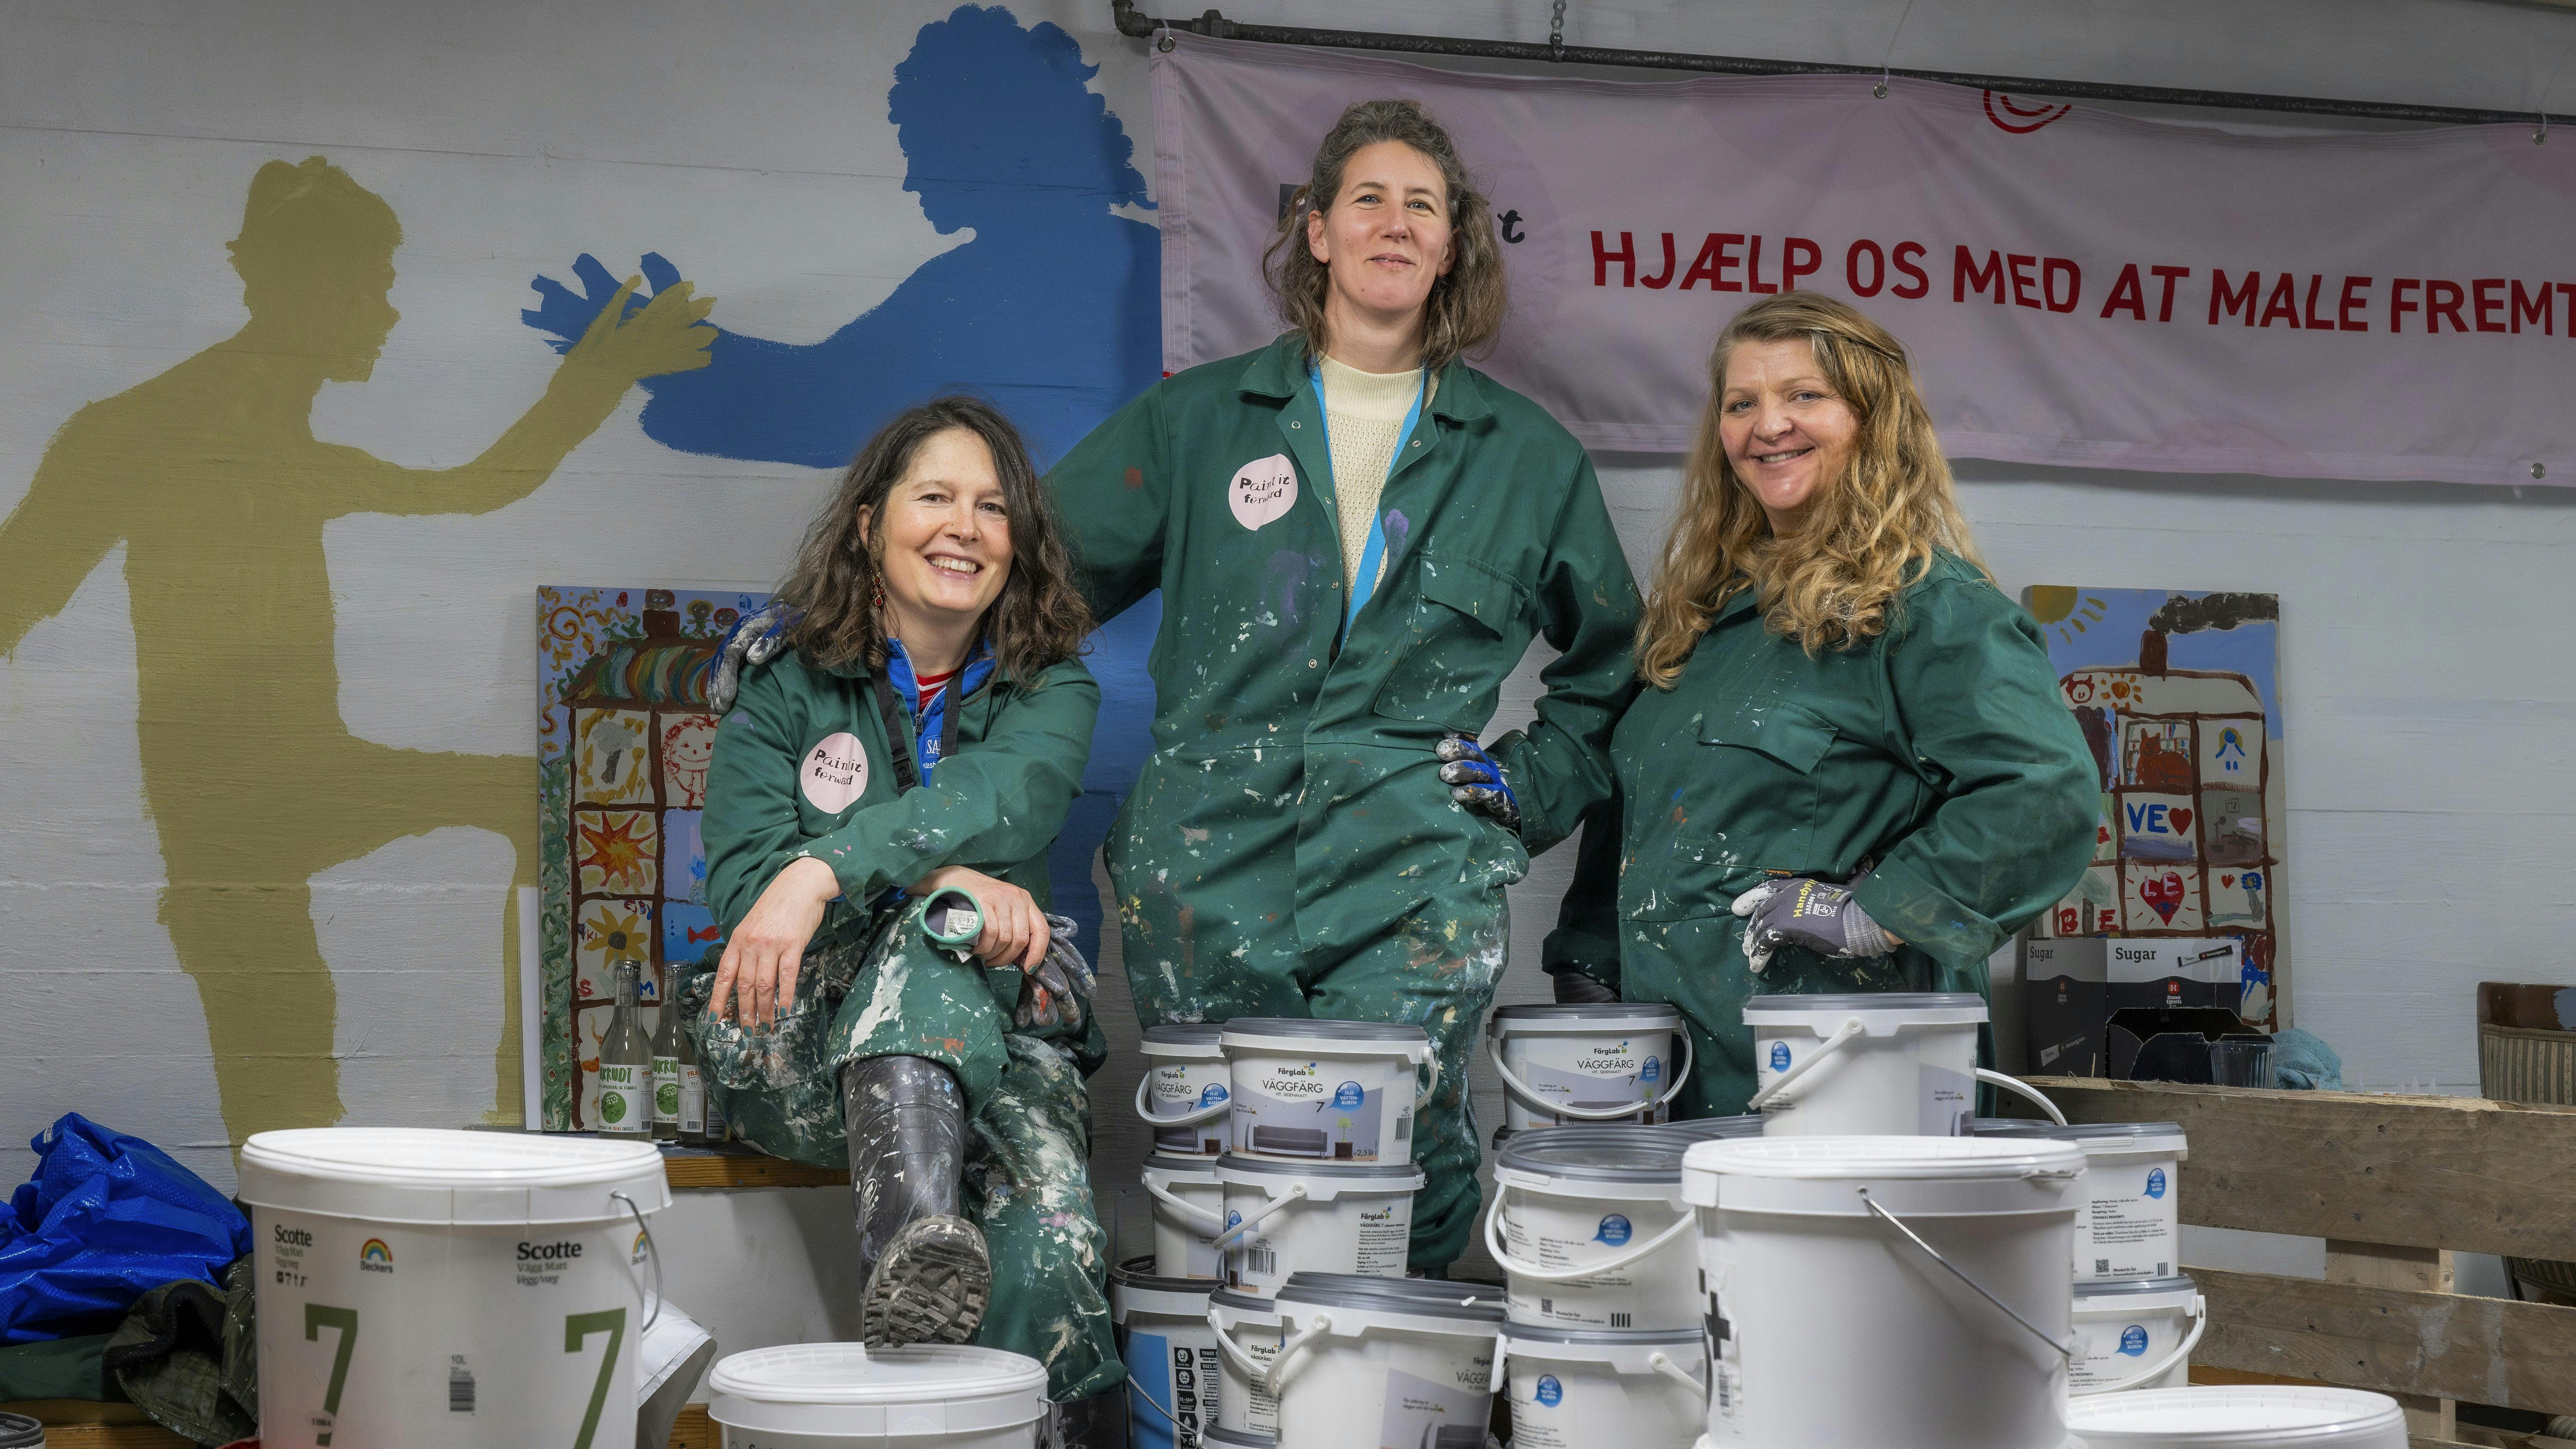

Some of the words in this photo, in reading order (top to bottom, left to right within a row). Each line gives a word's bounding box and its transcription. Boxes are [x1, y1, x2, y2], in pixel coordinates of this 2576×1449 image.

[1591, 230, 1823, 294] HJÆLP
[1846, 239, 1930, 300] OS
[1953, 245, 2081, 314] MED
[2099, 263, 2190, 322] AT
[2208, 269, 2372, 332] MALE
[2390, 278, 2576, 338] FREMT
[1239, 475, 1276, 492] Paint
[1279, 474, 1290, 486] it
[1805, 893, 1817, 915] 3555961
[2030, 946, 2054, 961] Sugar
[2116, 947, 2156, 963] Sugar
[1577, 1058, 1634, 1069] VÄGGFÄRG
[1278, 1068, 1306, 1076] FärgLab
[1154, 1081, 1192, 1094] VÄGGFÄRG
[1263, 1078, 1323, 1093] VÄGGFÄRG
[1628, 1076, 1636, 1086] 7
[1188, 1102, 1194, 1112] 7
[1316, 1102, 1325, 1112] 7
[1361, 1213, 1384, 1221] FärgLab
[275, 1224, 312, 1247] Scotte
[517, 1241, 582, 1261] Scotte
[360, 1260, 393, 1273] Beckers
[1252, 1345, 1276, 1354] FärgLab
[304, 1302, 358, 1448] 7
[564, 1307, 626, 1449] 7
